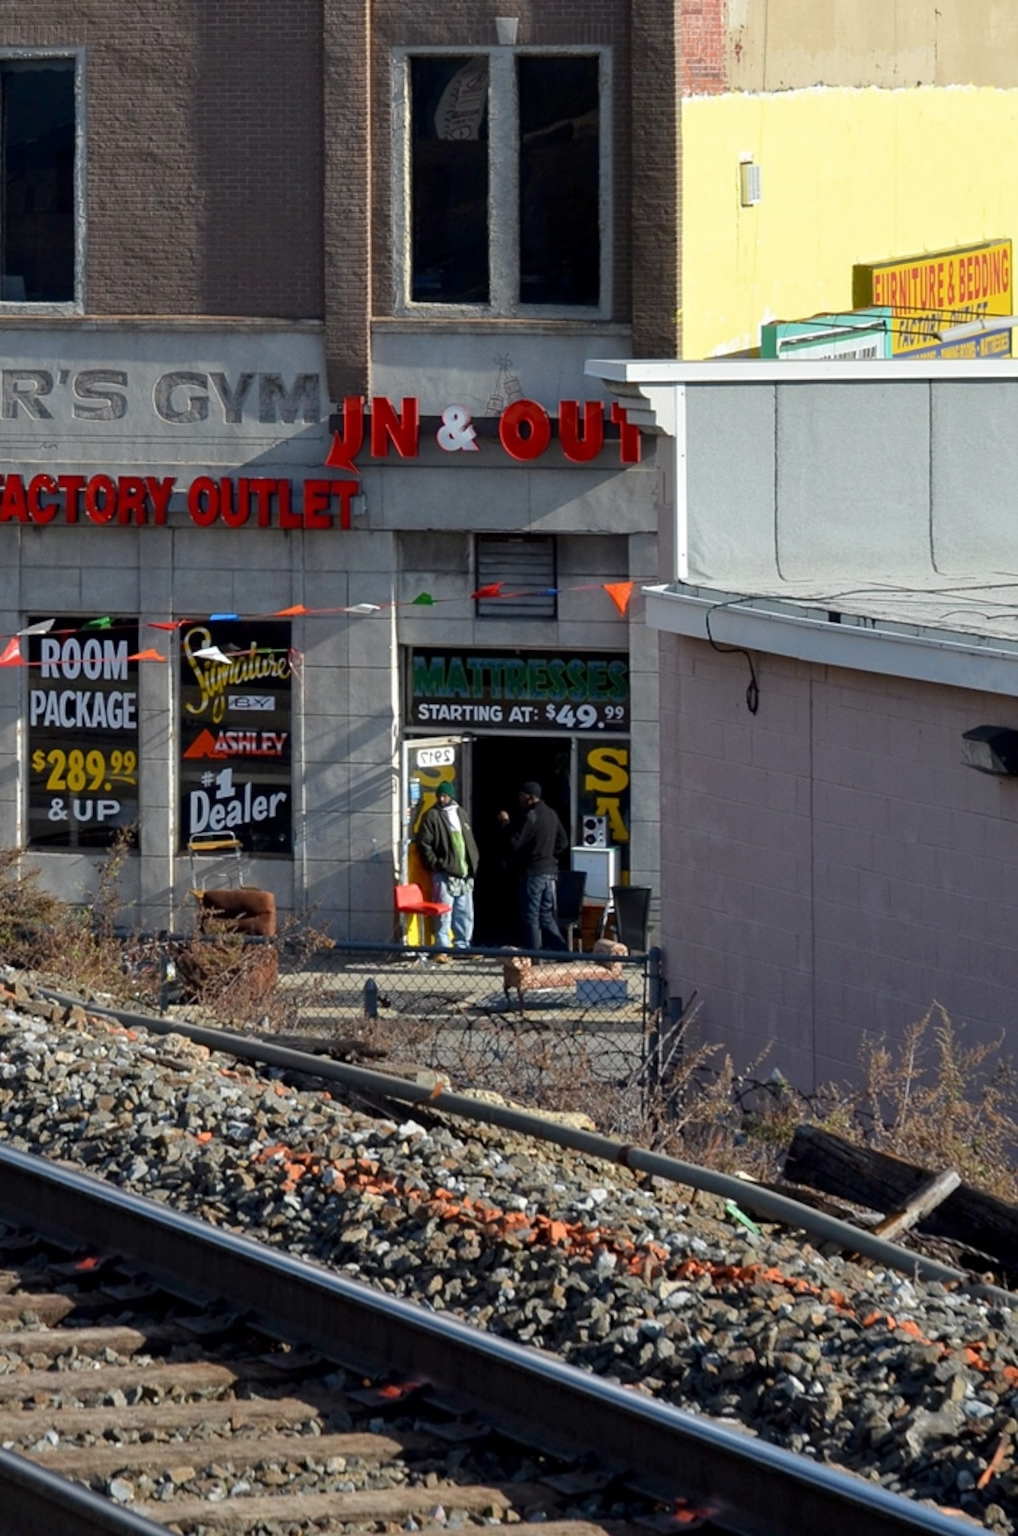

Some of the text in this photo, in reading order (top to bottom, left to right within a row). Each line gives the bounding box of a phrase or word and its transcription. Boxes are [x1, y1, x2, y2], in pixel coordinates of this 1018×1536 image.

[873, 248, 1009, 317] FURNITURE & BEDDING
[152, 371, 320, 426] GYM
[325, 395, 420, 475] IN
[436, 403, 481, 452] &
[188, 475, 362, 531] OUTLET
[40, 637, 128, 681] ROOM
[412, 655, 630, 704] MATTRESSES
[29, 689, 138, 730] PACKAGE
[234, 697, 272, 708] BY
[418, 703, 625, 730] STARTING AT: $49.99
[213, 732, 288, 756] ASHLEY
[32, 748, 137, 792] $289.99
[201, 767, 236, 799] #1
[48, 797, 122, 822] & UP
[189, 781, 287, 835] Dealer
